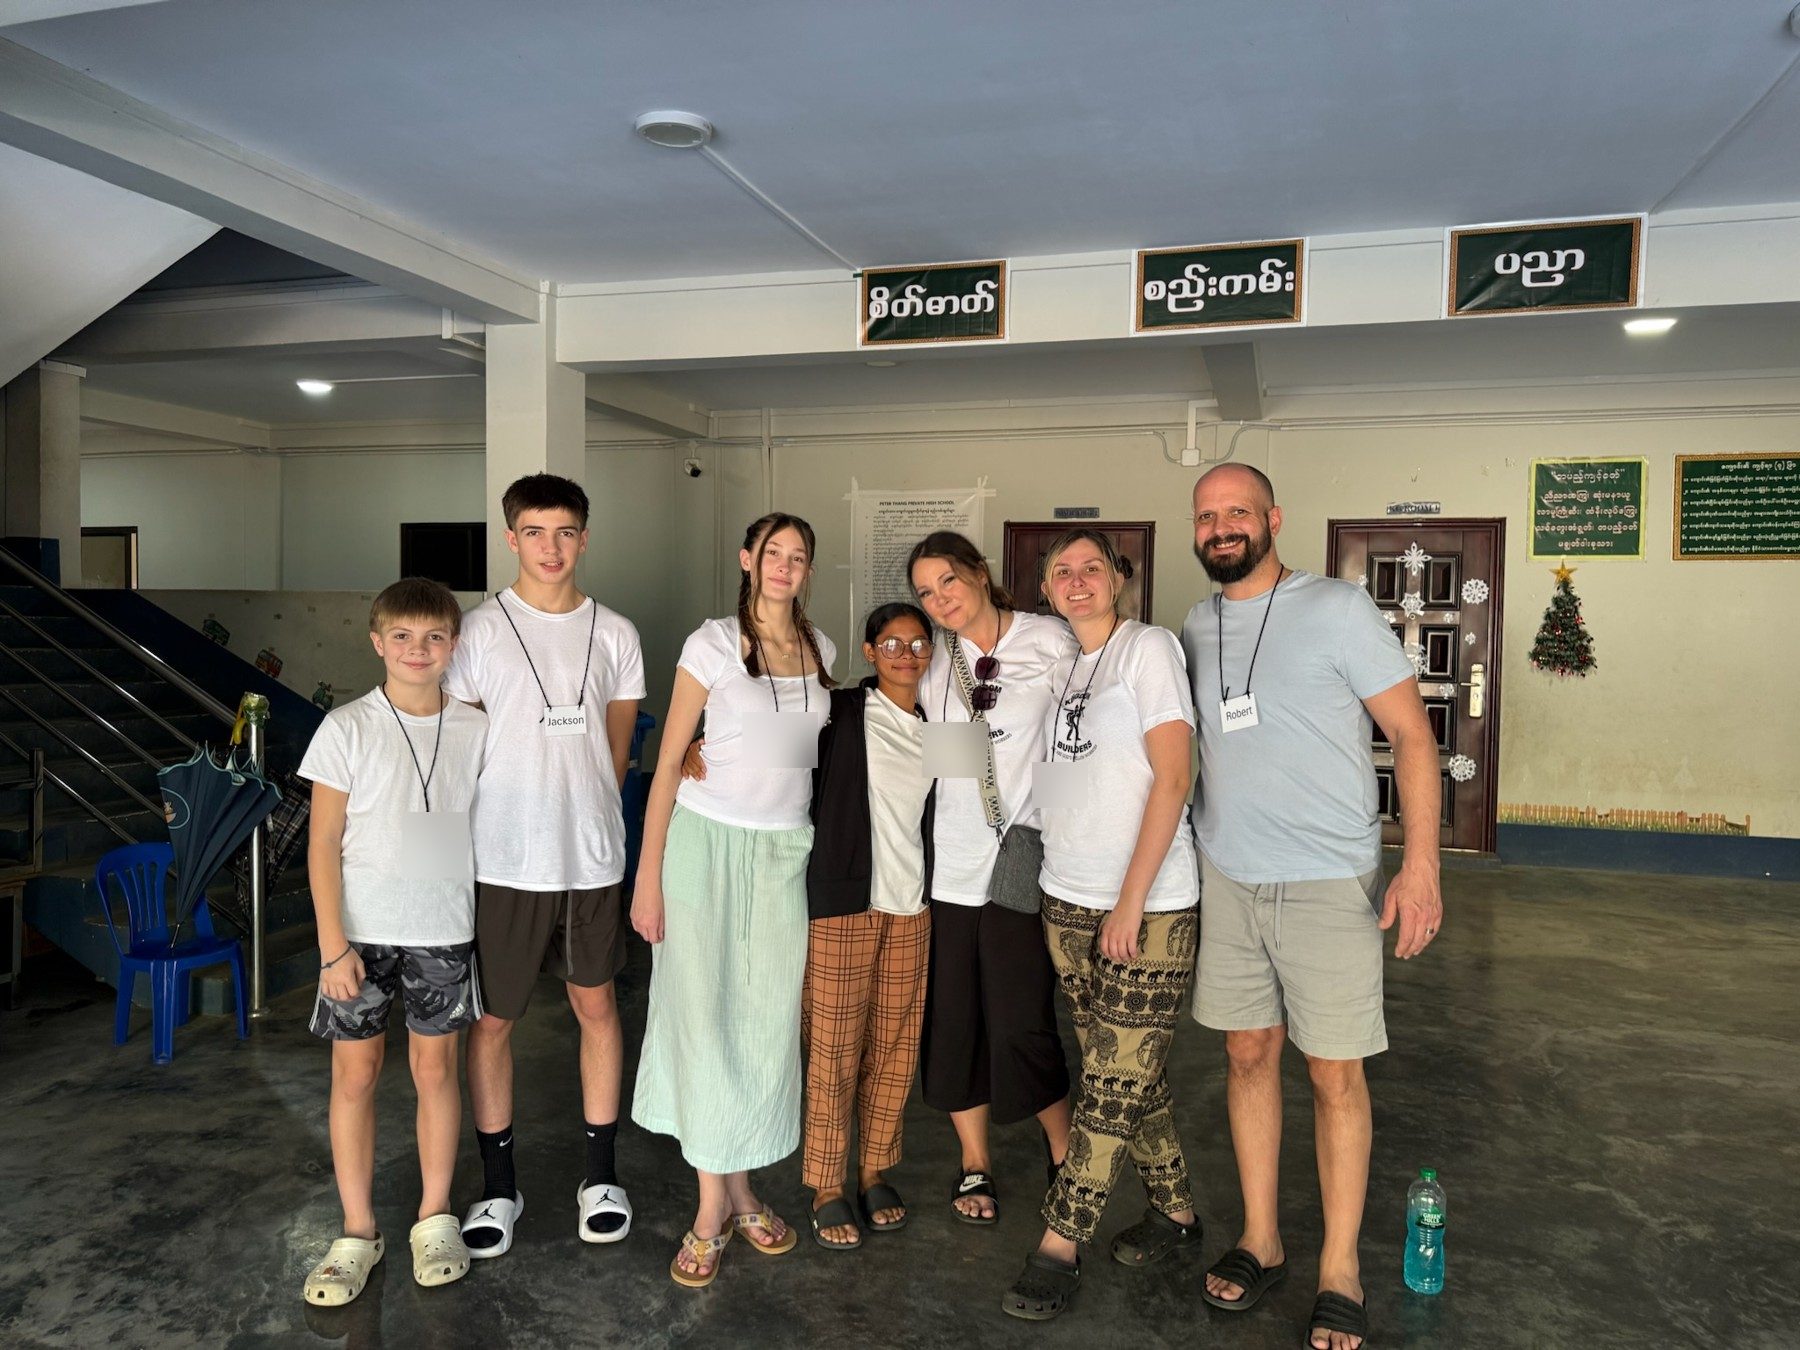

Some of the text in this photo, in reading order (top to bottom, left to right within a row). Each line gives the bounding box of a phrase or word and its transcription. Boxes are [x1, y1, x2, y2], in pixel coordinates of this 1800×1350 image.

[1494, 248, 1585, 288] ပညာ
[1144, 258, 1295, 313] စည်းကမ်း
[869, 280, 999, 319] စိတ်ဓာတ်
[1226, 706, 1253, 721] Robert
[547, 717, 584, 727] Jackson
[1057, 739, 1092, 754] BUILDERS
[963, 1174, 984, 1186] NIKE
